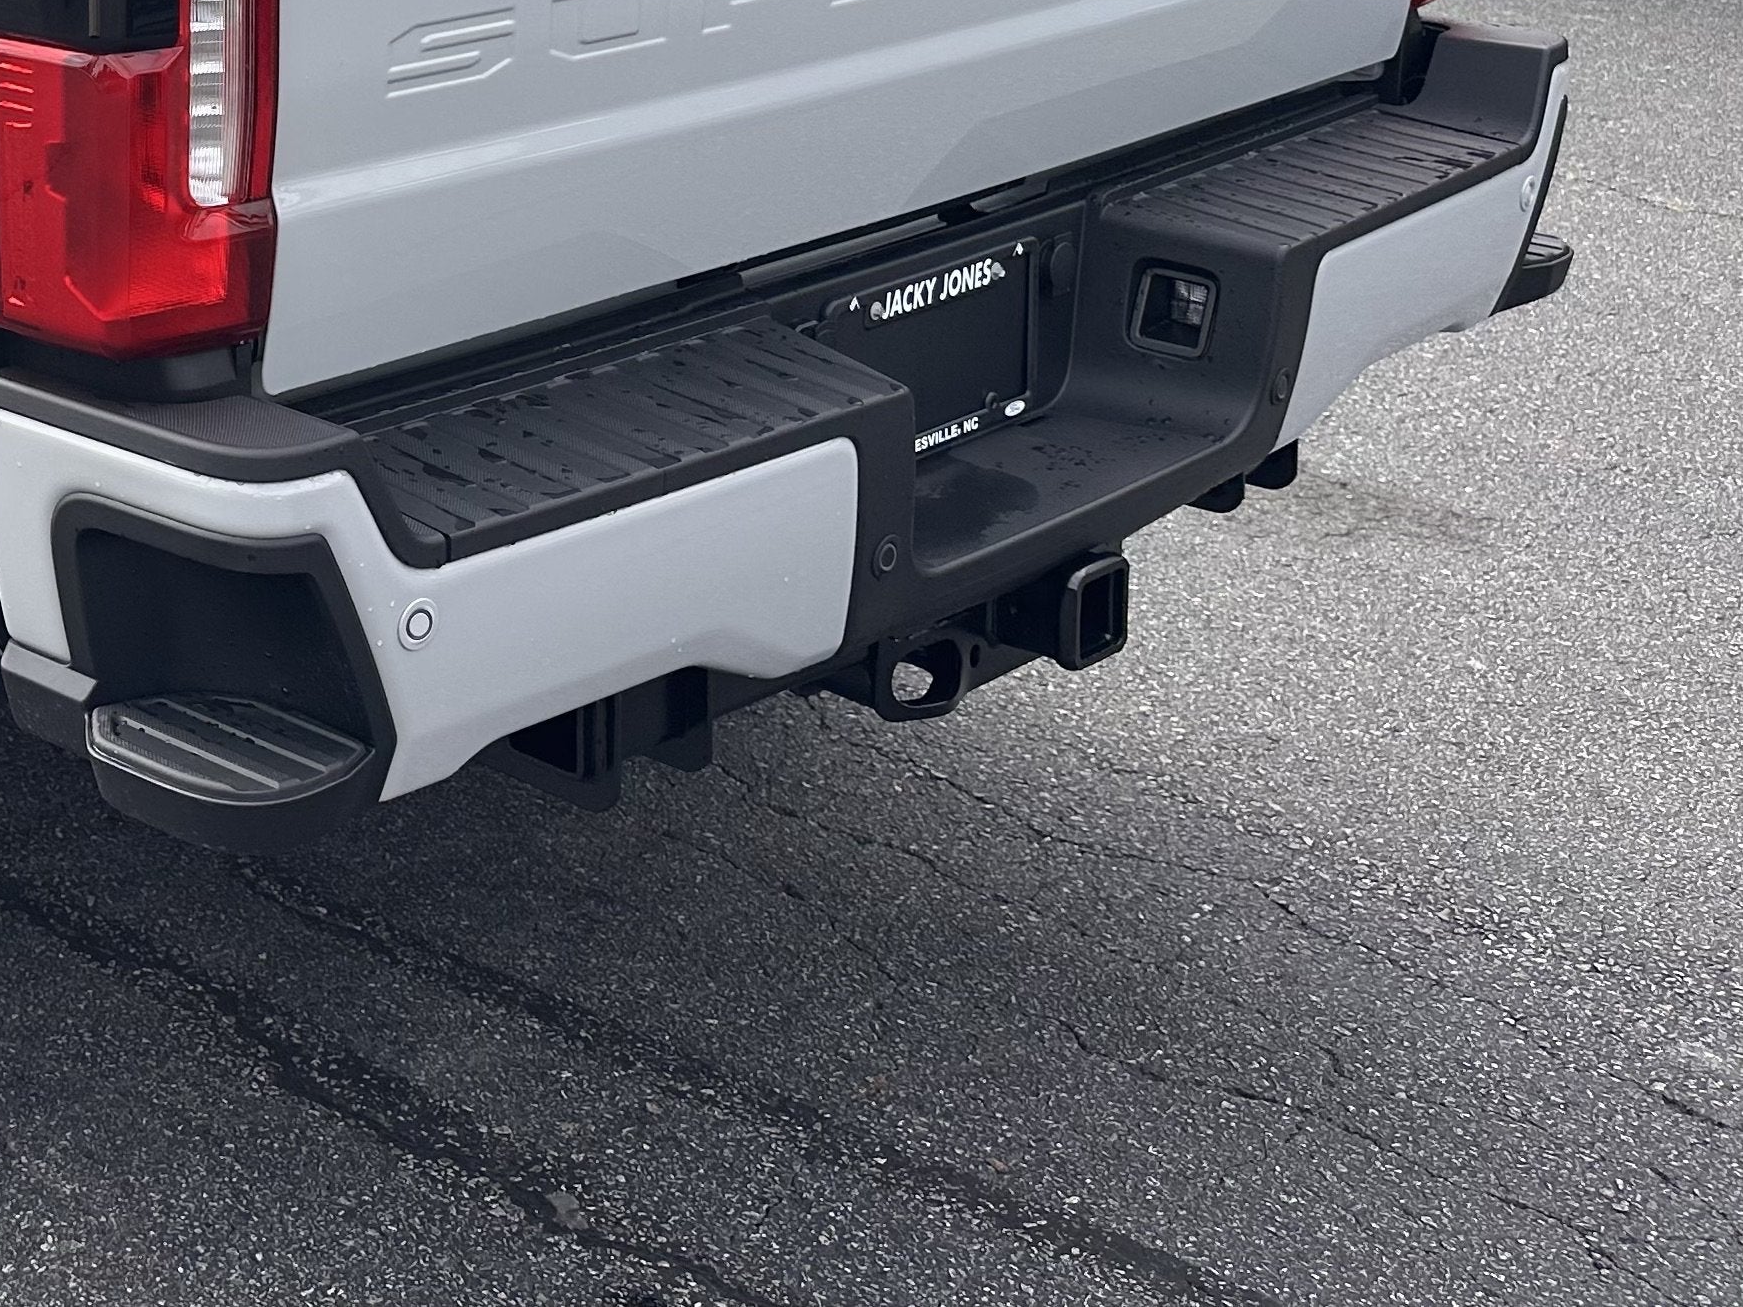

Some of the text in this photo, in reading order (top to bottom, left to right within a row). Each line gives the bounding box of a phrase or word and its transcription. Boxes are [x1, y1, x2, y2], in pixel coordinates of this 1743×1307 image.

[881, 258, 992, 320] JACKY JONES
[914, 416, 979, 452] ESVILLE, NC
